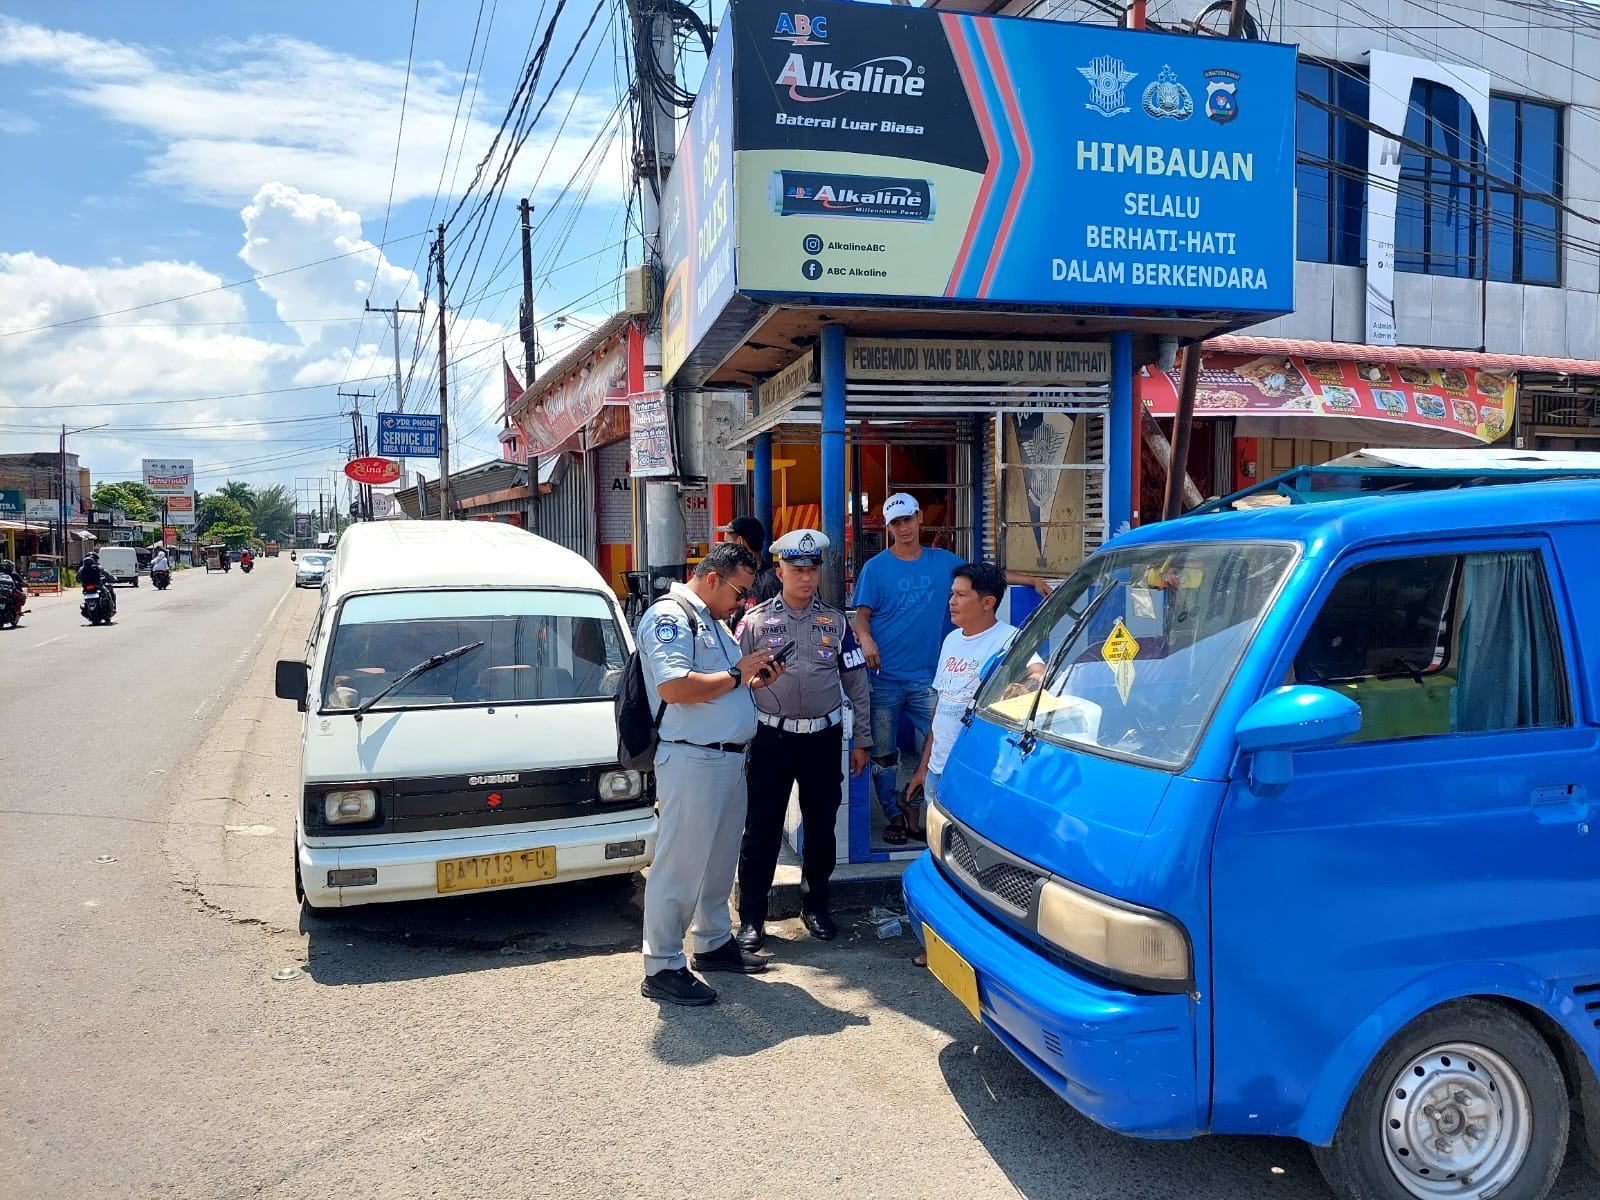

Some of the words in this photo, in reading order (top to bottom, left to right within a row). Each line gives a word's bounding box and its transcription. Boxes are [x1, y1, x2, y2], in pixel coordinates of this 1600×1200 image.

[775, 12, 827, 38] ABC
[776, 53, 925, 98] Alkaline
[776, 113, 836, 129] Baterai
[841, 117, 878, 133] Luar
[880, 121, 925, 136] Biasa
[702, 124, 721, 200] POS
[1076, 140, 1255, 182] HIMBAUAN
[788, 186, 813, 198] ABC
[813, 184, 922, 206] Alkaline
[1124, 192, 1200, 219] SELALU
[855, 206, 898, 215] Millennium
[697, 177, 728, 272] POLISI
[827, 241, 886, 253] AlkalineABC
[1086, 225, 1237, 255] BERHATI-HATI
[826, 266, 847, 277] ABC
[848, 267, 887, 278] Alkaline
[1052, 258, 1125, 284] DALAM
[1132, 262, 1269, 290] BERKENDARA
[852, 346, 919, 371] PENGEMUDI
[922, 348, 951, 371] YANG
[956, 348, 986, 373] BAIK,
[988, 349, 1024, 372] SABAR
[1028, 350, 1052, 372] DAN
[1056, 350, 1107, 373] HATI-HATI
[412, 418, 437, 427] PHONE
[383, 431, 420, 446] SERVICE
[423, 432, 436, 446] HP
[383, 444, 399, 453] BISA
[400, 445, 407, 453] DI
[408, 445, 435, 454] TUNGGU
[897, 575, 933, 592] OLD
[812, 624, 838, 634] POLRI
[469, 773, 520, 786] SUZUKI
